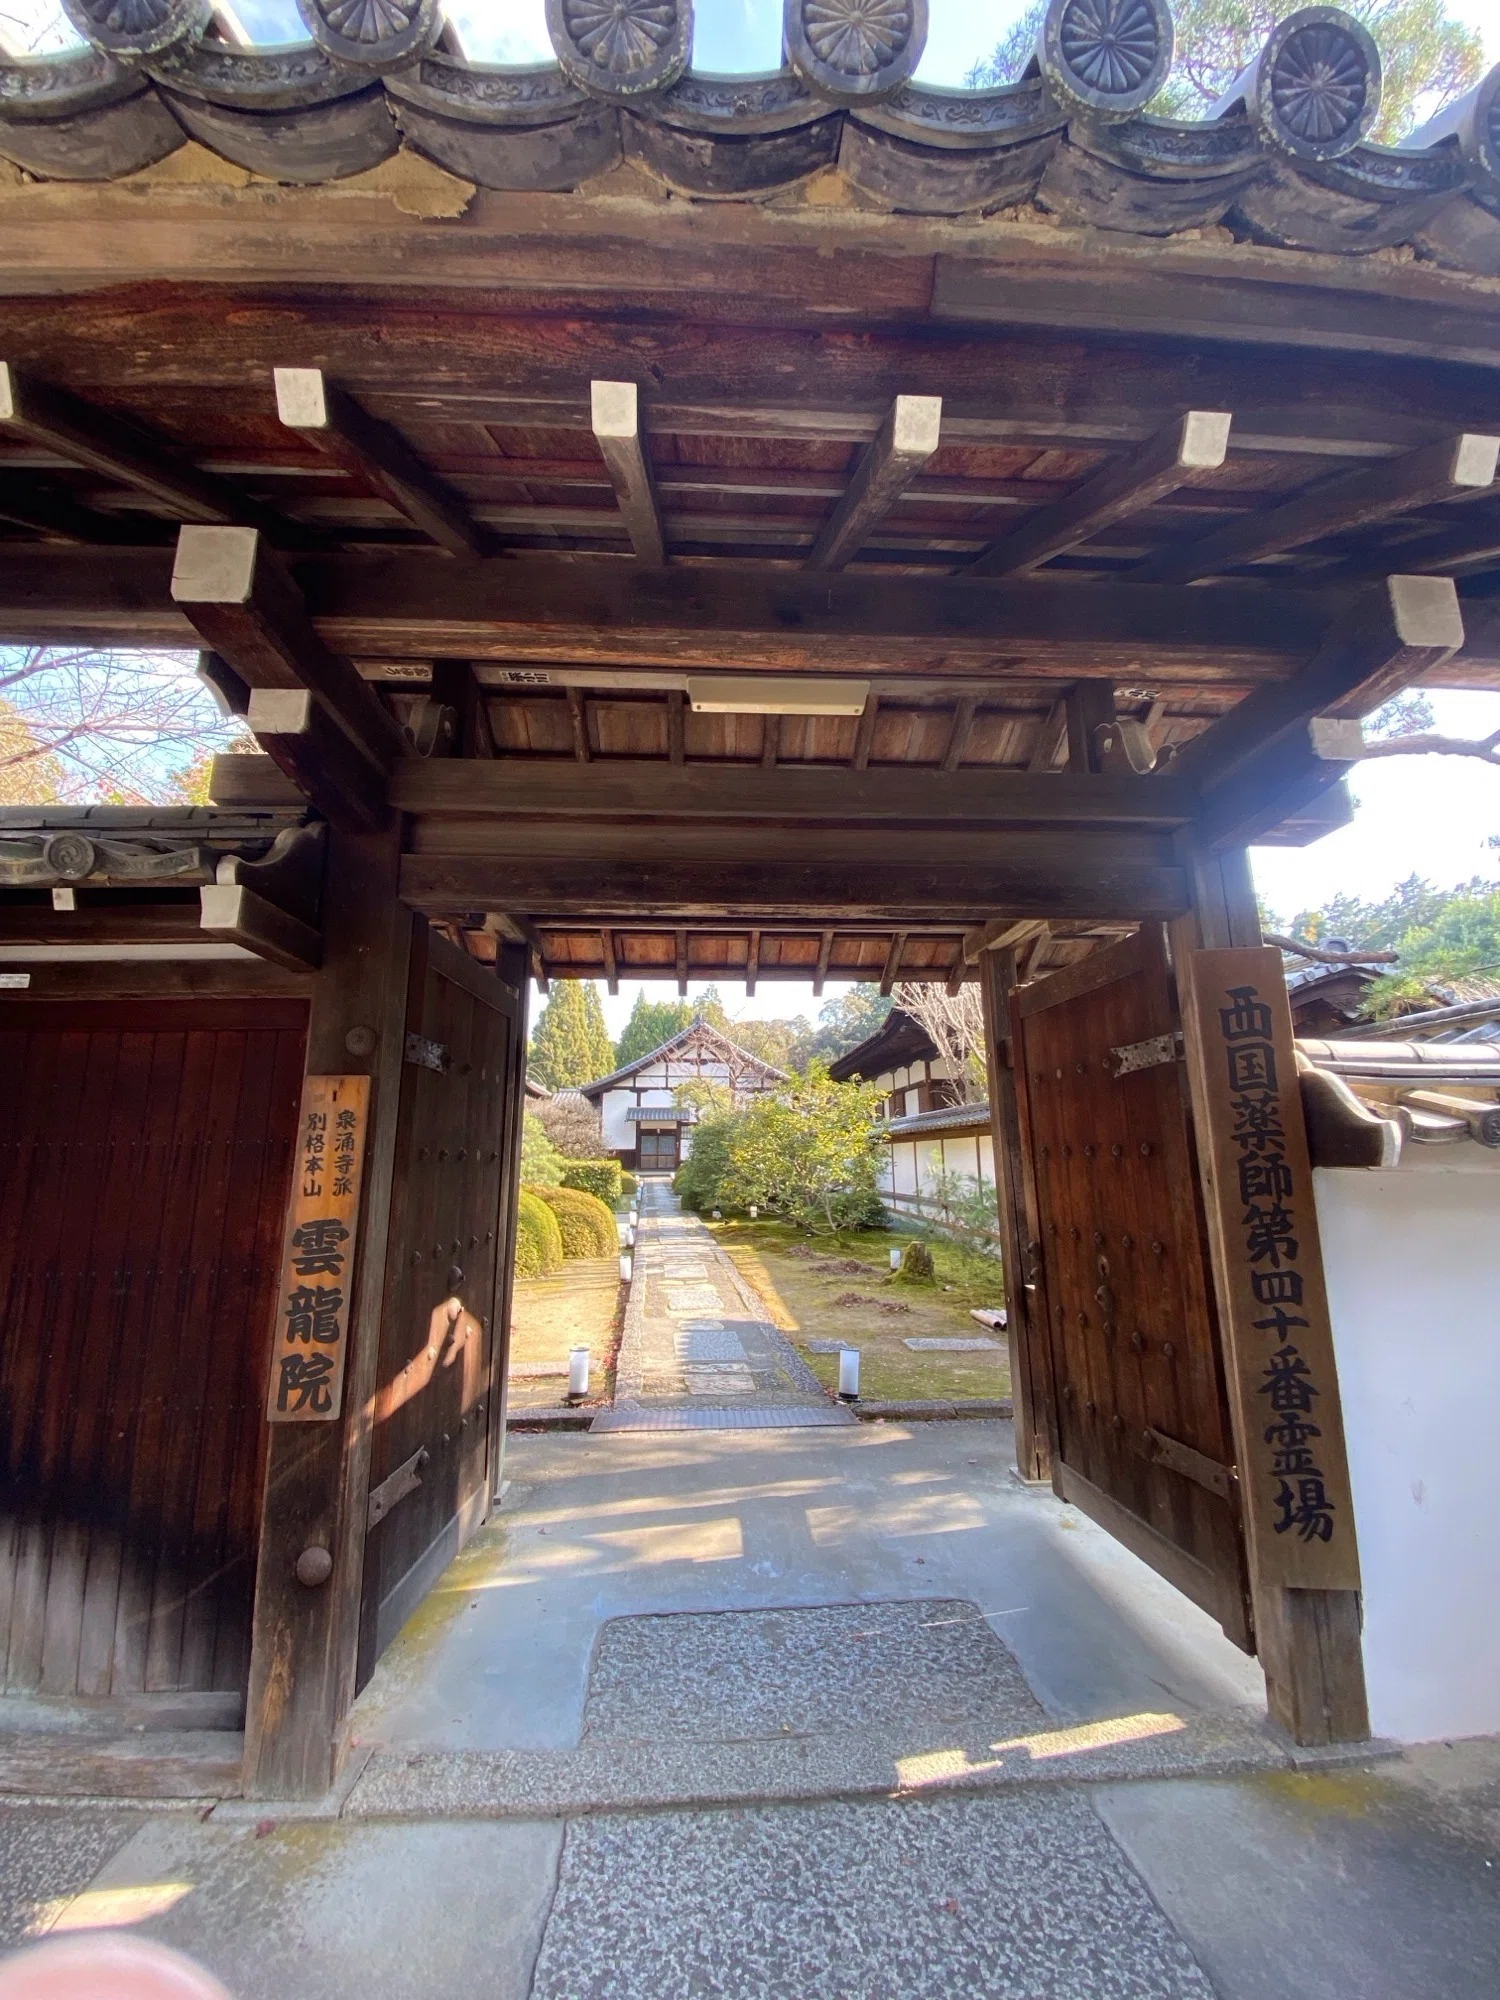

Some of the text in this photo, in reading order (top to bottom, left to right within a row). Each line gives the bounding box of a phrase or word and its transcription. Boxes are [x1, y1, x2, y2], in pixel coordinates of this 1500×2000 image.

[303, 1112, 327, 1197] 別格本山
[332, 1109, 356, 1196] 泉涌寺派
[276, 1218, 349, 1413] 雲龍院
[1218, 985, 1335, 1543] 西国薬師第四十番霊場
